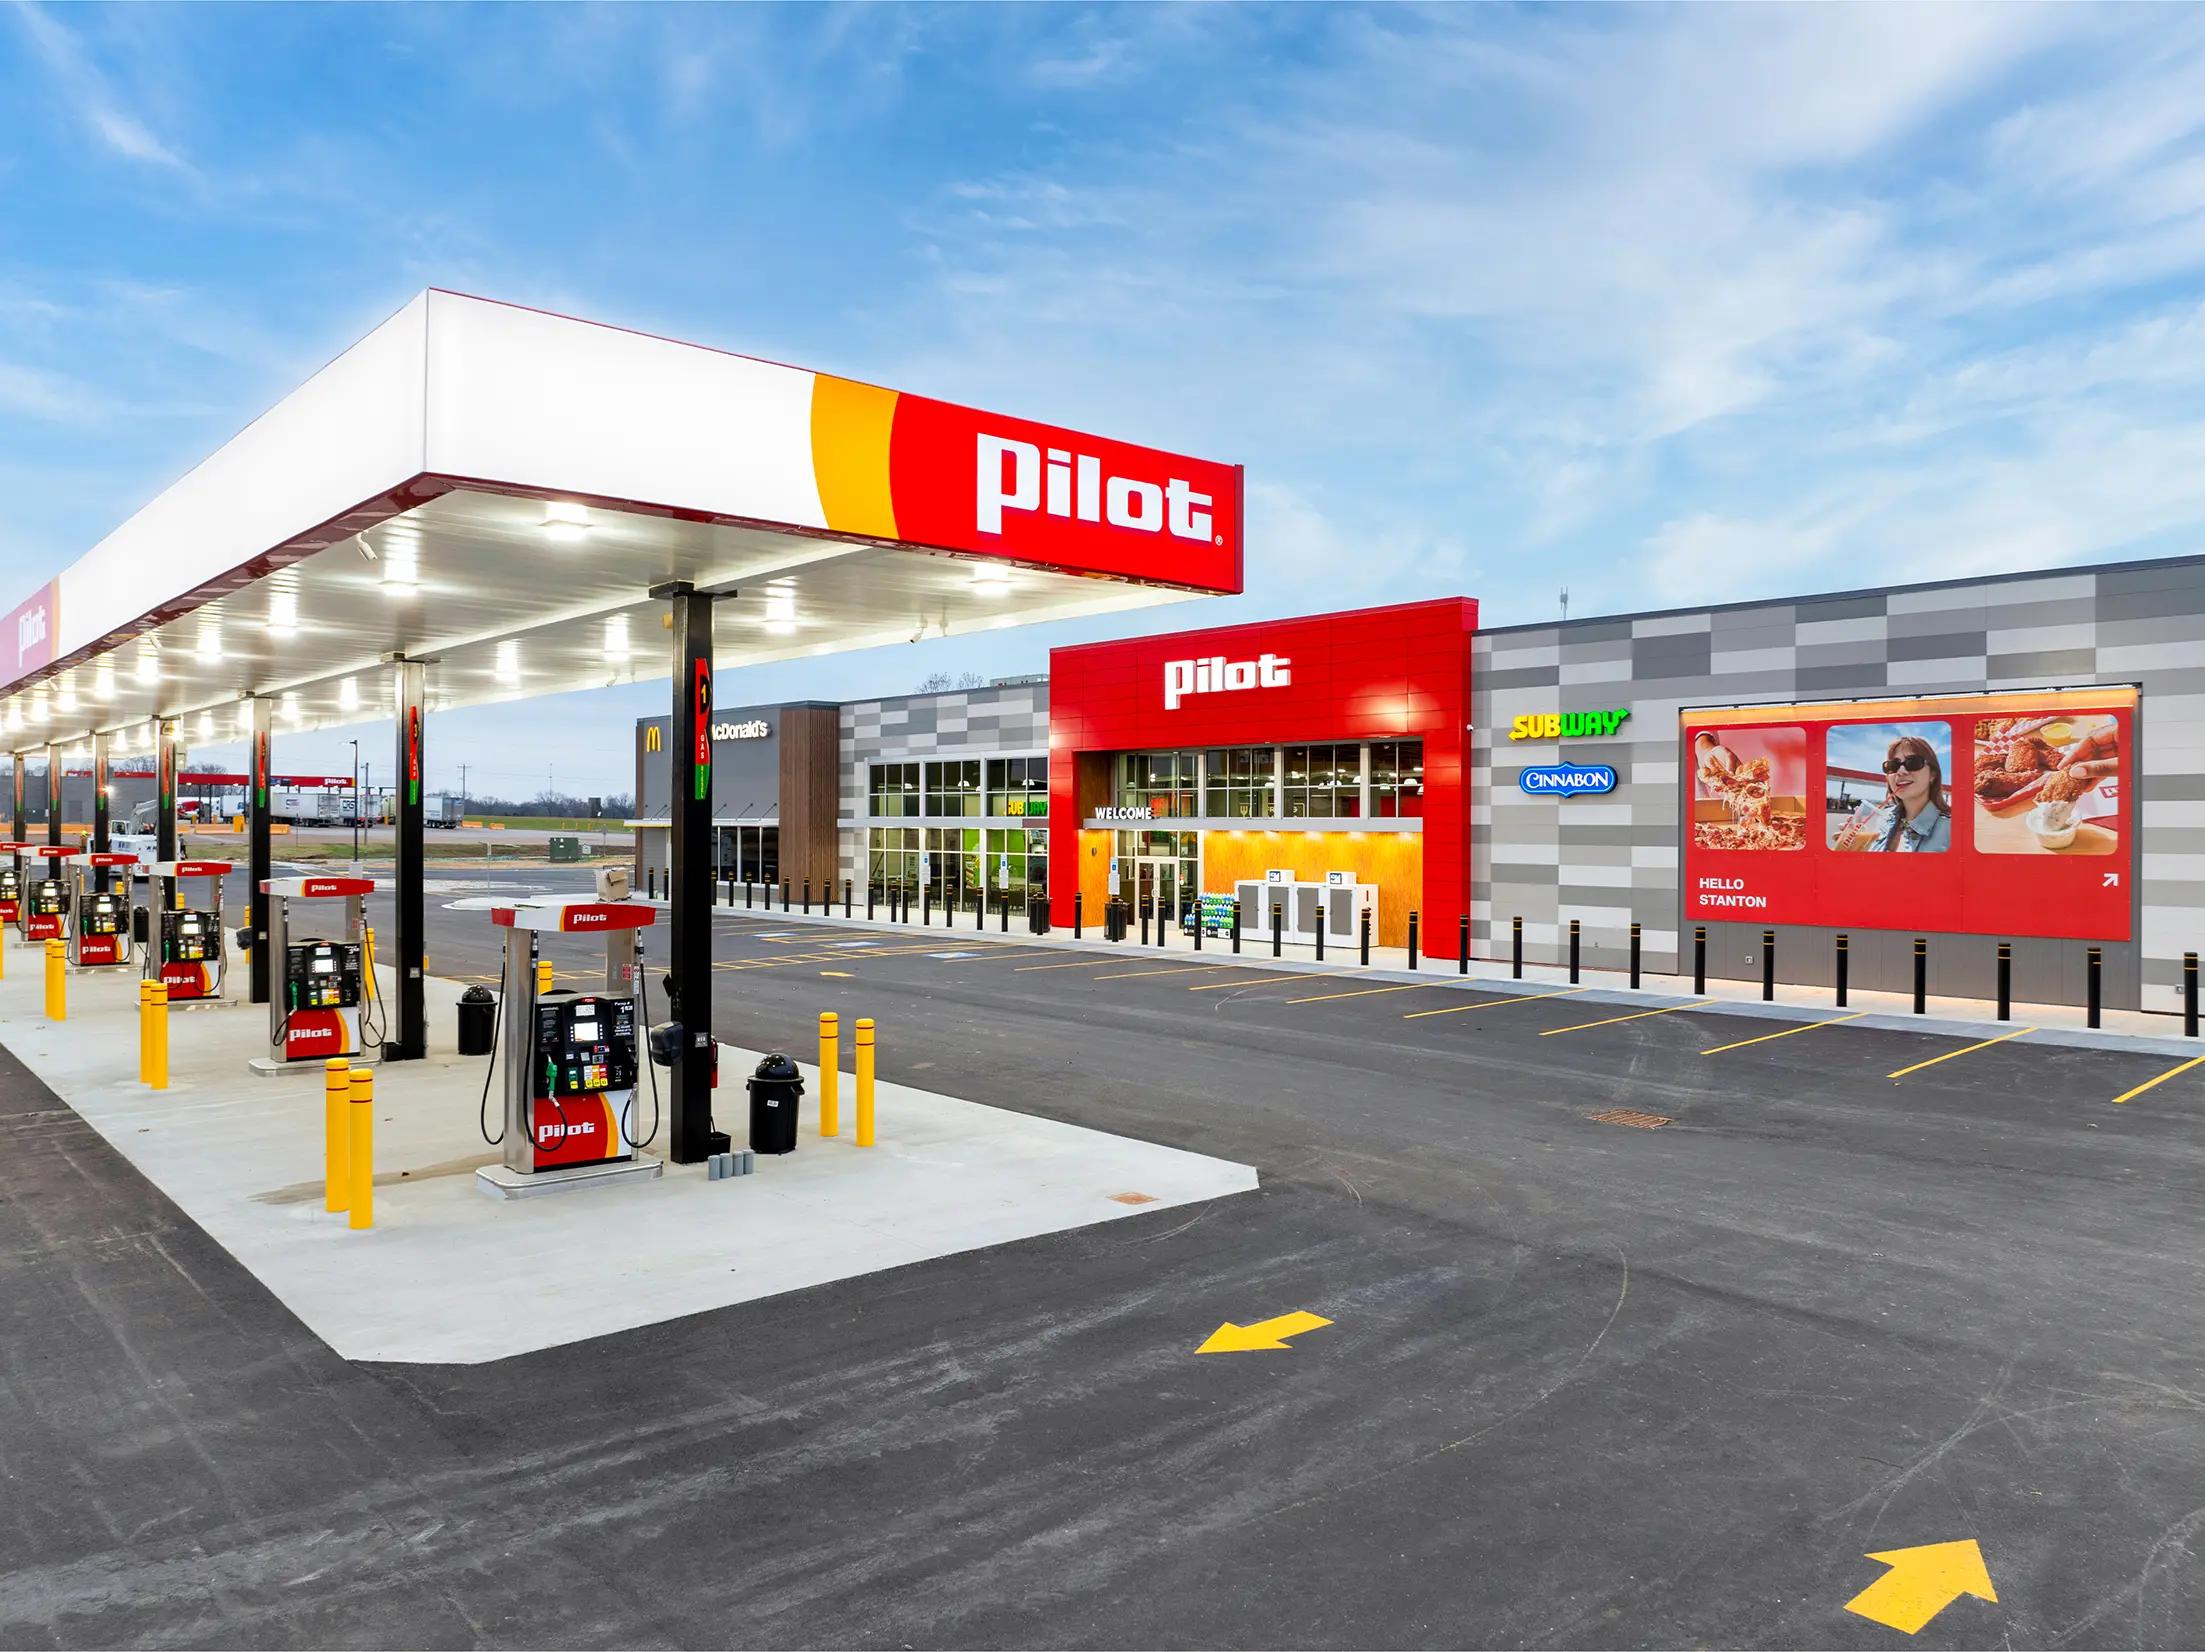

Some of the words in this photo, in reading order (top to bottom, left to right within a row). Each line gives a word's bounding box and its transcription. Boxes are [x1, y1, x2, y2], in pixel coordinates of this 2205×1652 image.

[1164, 653, 1292, 712] Pilot
[700, 684, 707, 704] 1
[1508, 708, 1630, 741] SUBWAY
[1526, 771, 1609, 788] CINNABON
[1095, 806, 1153, 820] WELCOME
[310, 883, 338, 892] Pilot
[1699, 877, 1745, 890] HELLO
[1699, 893, 1767, 908] STANTON
[573, 913, 608, 925] Pilot
[289, 1026, 333, 1042] Pilot
[538, 1121, 596, 1143] Pilot
